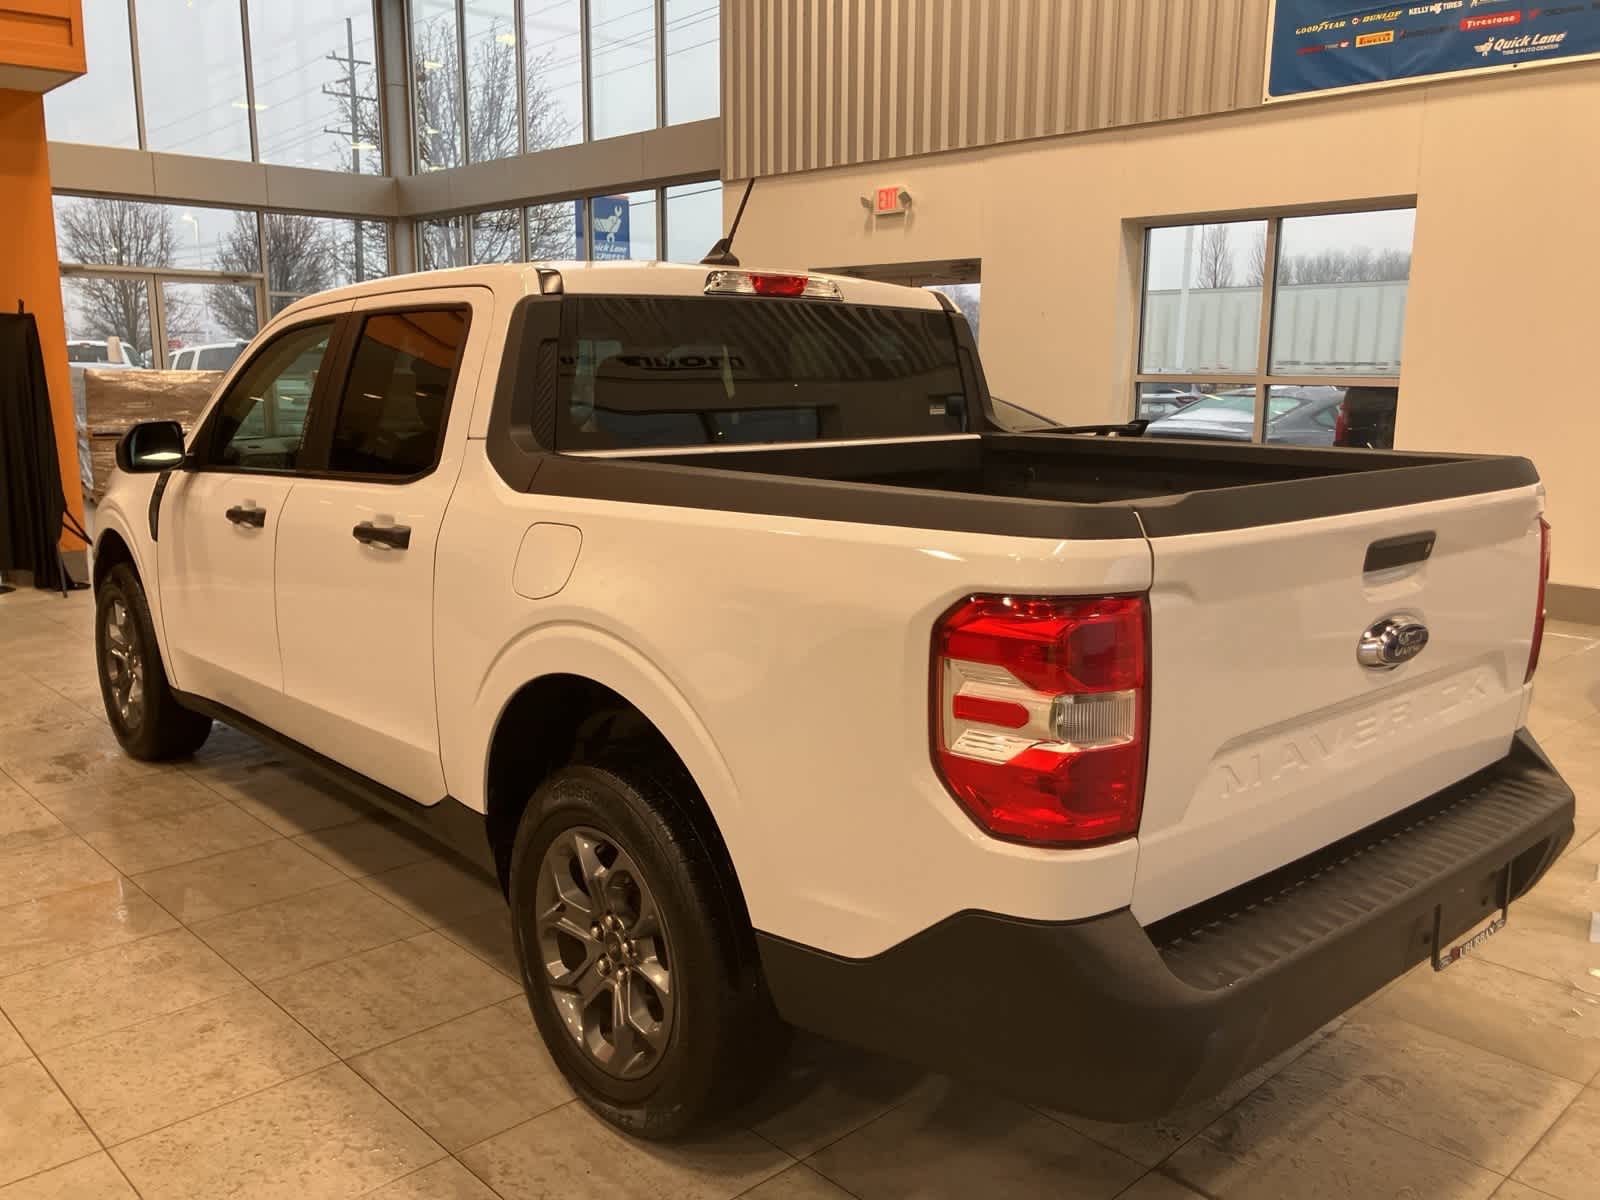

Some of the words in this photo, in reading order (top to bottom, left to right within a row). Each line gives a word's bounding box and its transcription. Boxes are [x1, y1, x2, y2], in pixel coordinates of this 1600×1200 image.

[1408, 6, 1428, 16] KELLY
[1442, 0, 1463, 11] TIRES
[1362, 10, 1402, 23] DUNLOP
[1466, 14, 1516, 29] Firestone
[1295, 20, 1346, 35] GOODYEAR
[1493, 34, 1531, 52] Quick
[1530, 31, 1568, 46] Lane
[1219, 676, 1489, 799] MAVERICK
